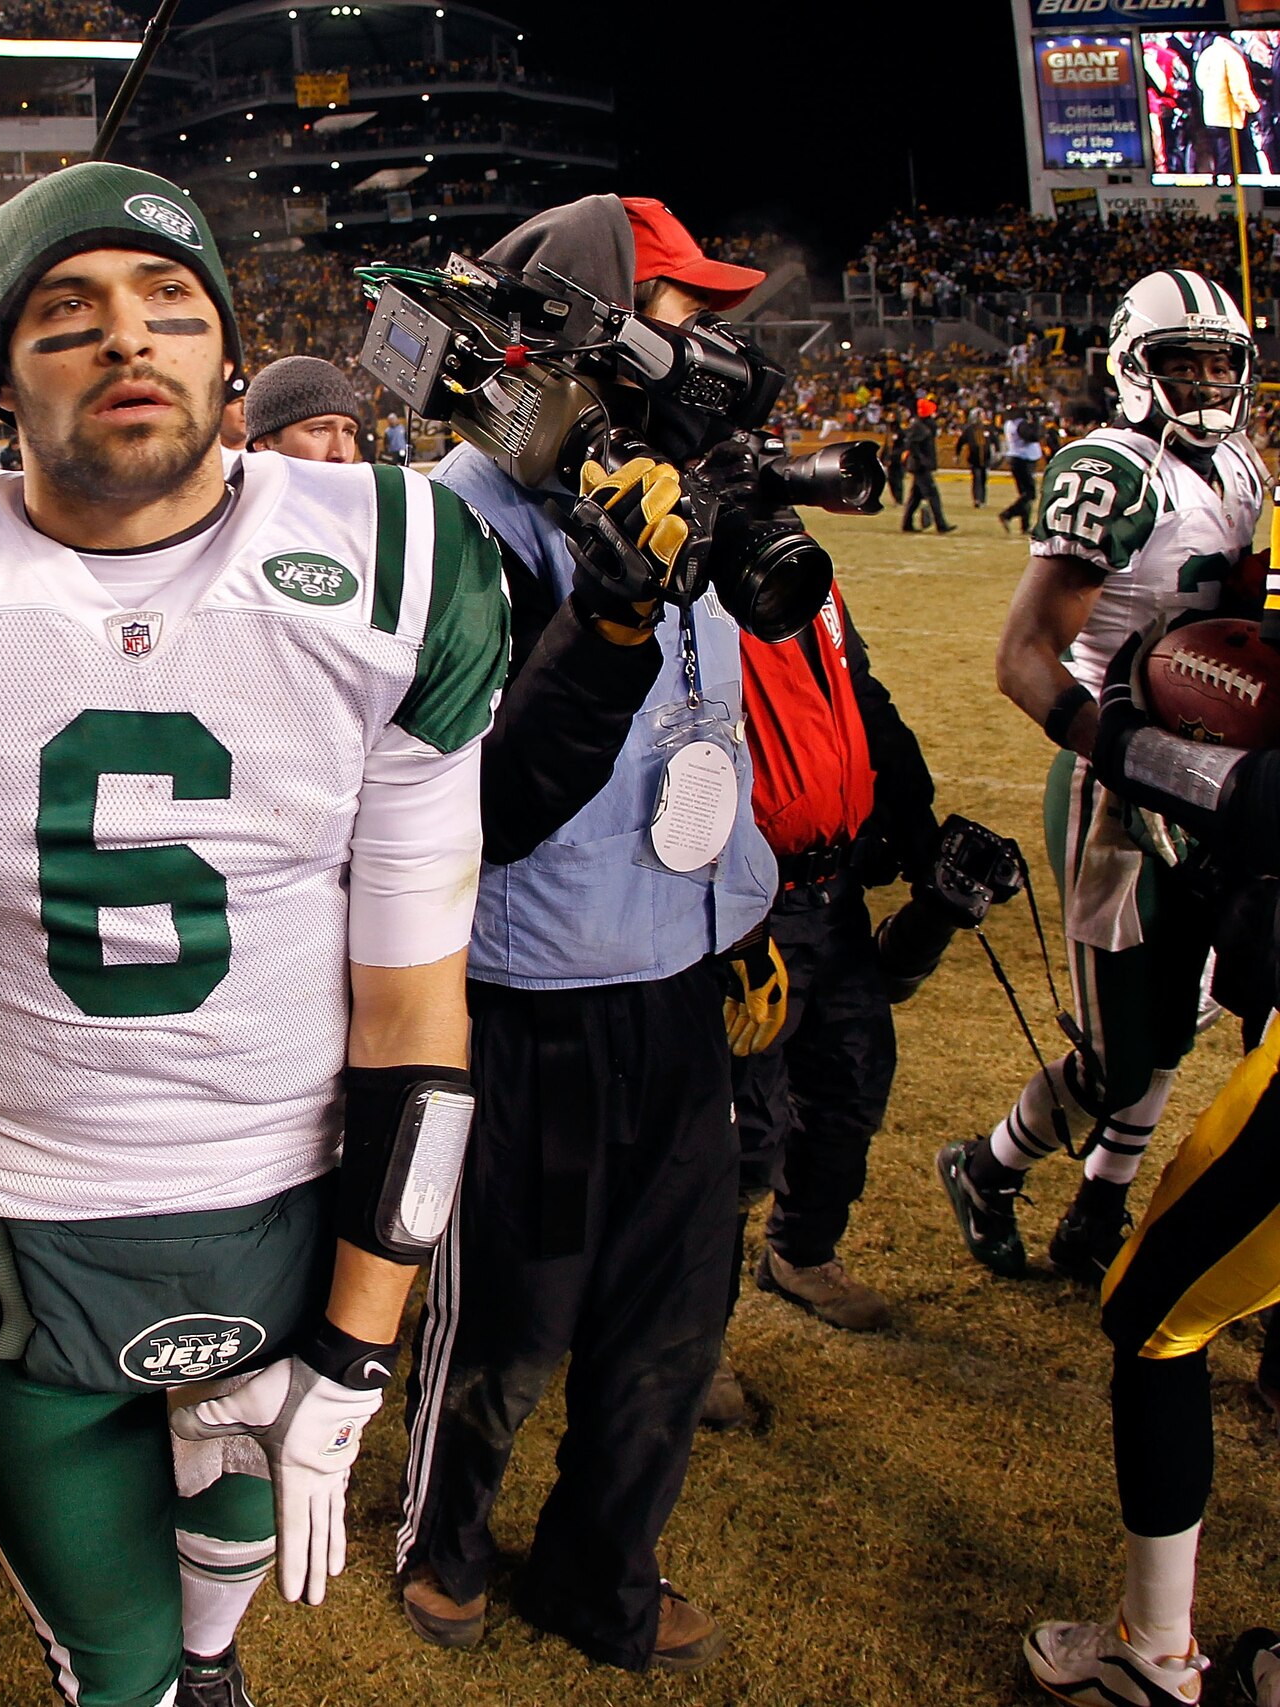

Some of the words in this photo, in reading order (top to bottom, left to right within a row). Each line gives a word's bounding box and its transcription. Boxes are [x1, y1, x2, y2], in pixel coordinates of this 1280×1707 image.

[1047, 51, 1120, 68] GIANT
[1051, 67, 1120, 83] EAGLE
[1065, 105, 1115, 118] Official
[1048, 120, 1136, 136] Supermarket
[1072, 136, 1087, 148] of
[1090, 136, 1114, 148] the
[1104, 197, 1148, 209] YOUR
[1046, 472, 1117, 545] 22
[274, 566, 343, 588] JETS
[124, 637, 150, 652] NFL
[35, 708, 233, 1018] 6
[143, 1339, 240, 1369] JETS
